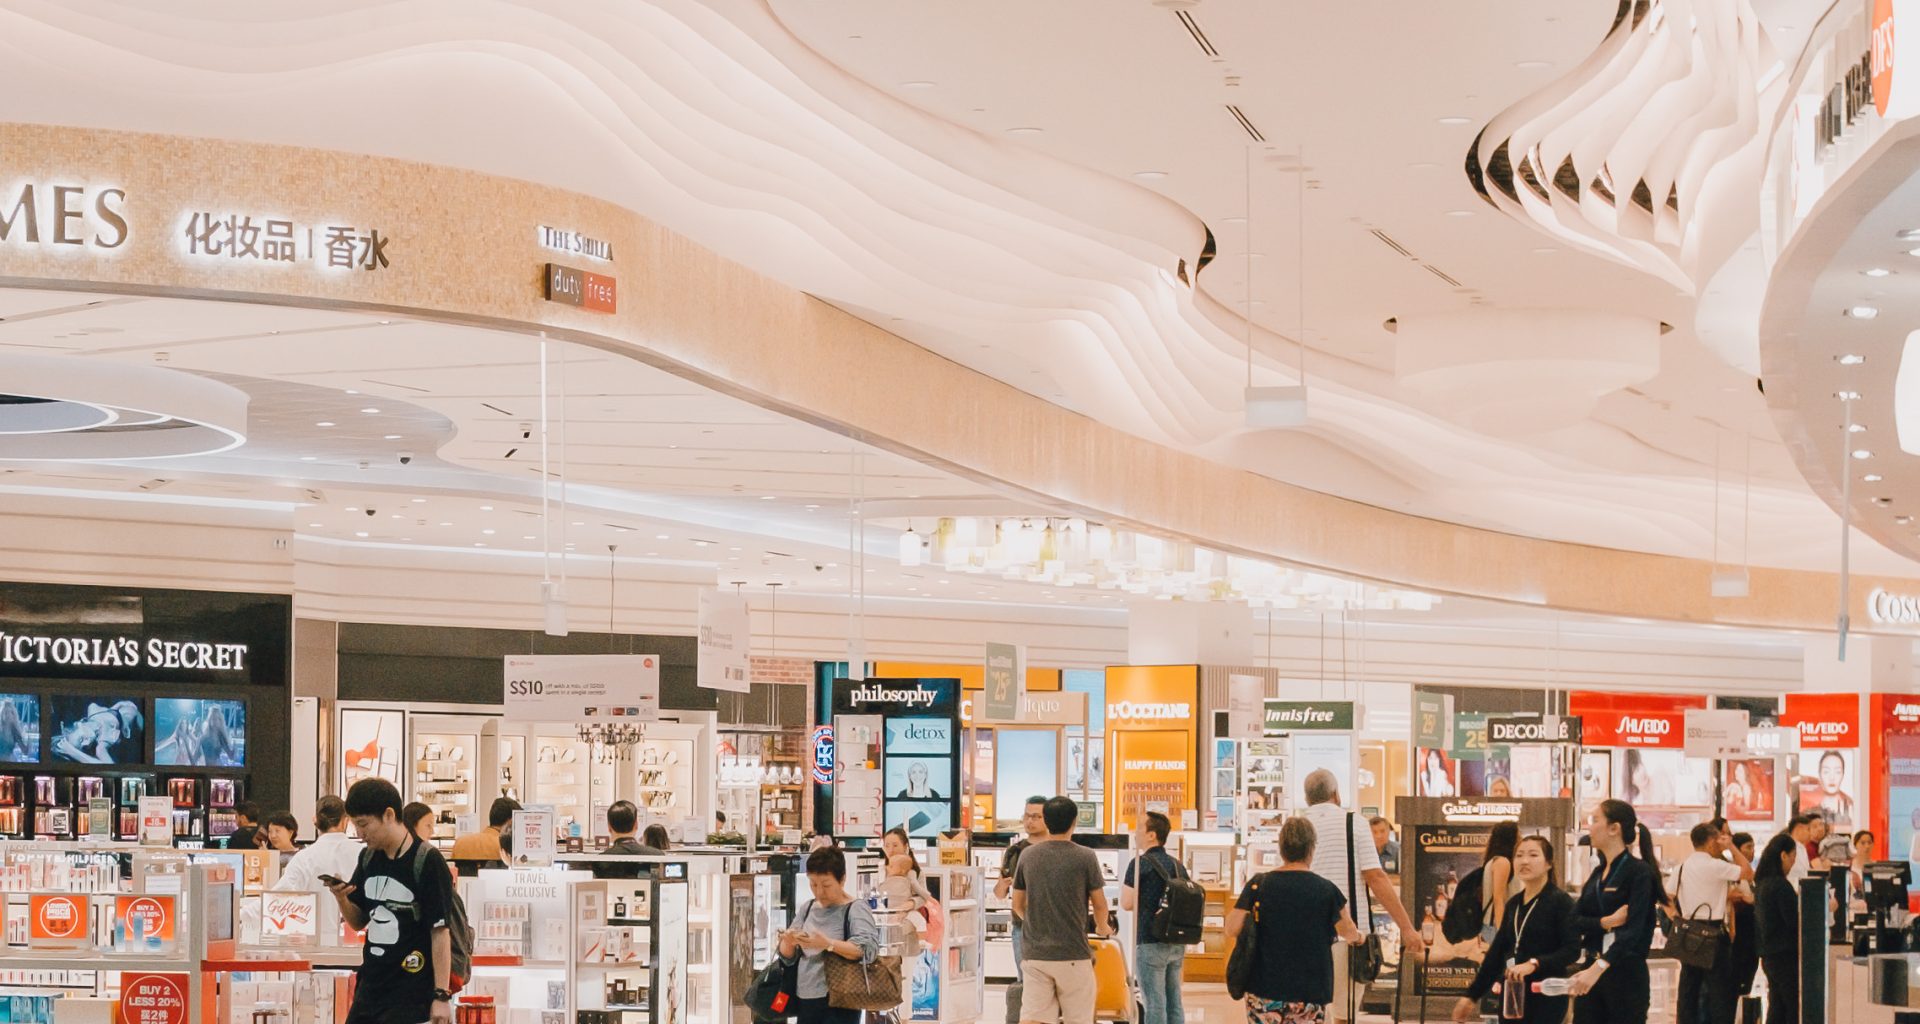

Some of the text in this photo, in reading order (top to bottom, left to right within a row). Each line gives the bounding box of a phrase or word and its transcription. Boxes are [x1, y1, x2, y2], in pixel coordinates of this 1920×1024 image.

[1872, 16, 1894, 79] DFS
[185, 211, 390, 271] 化妆品 香水
[543, 225, 614, 261] THE SHILLA
[554, 269, 612, 303] duty free
[0, 631, 248, 671] ICTORIA'S SECRET
[850, 684, 938, 707] philosophy
[1108, 701, 1190, 719] L'OCCITANE
[904, 723, 946, 739] detox
[1493, 721, 1569, 739] DECORÉ
[1615, 716, 1670, 734] SHISEIDO
[1124, 760, 1186, 770] HAPPY HANDS
[1442, 802, 1473, 815] GAME
[1476, 802, 1523, 815] THRONES
[1420, 832, 1451, 845] GAME
[1458, 833, 1489, 846] THRO
[514, 873, 548, 884] TRAVEL
[505, 886, 557, 898] EXCLUSIVE
[139, 985, 171, 995] BUY 2
[129, 997, 181, 1007] LESS 20%
